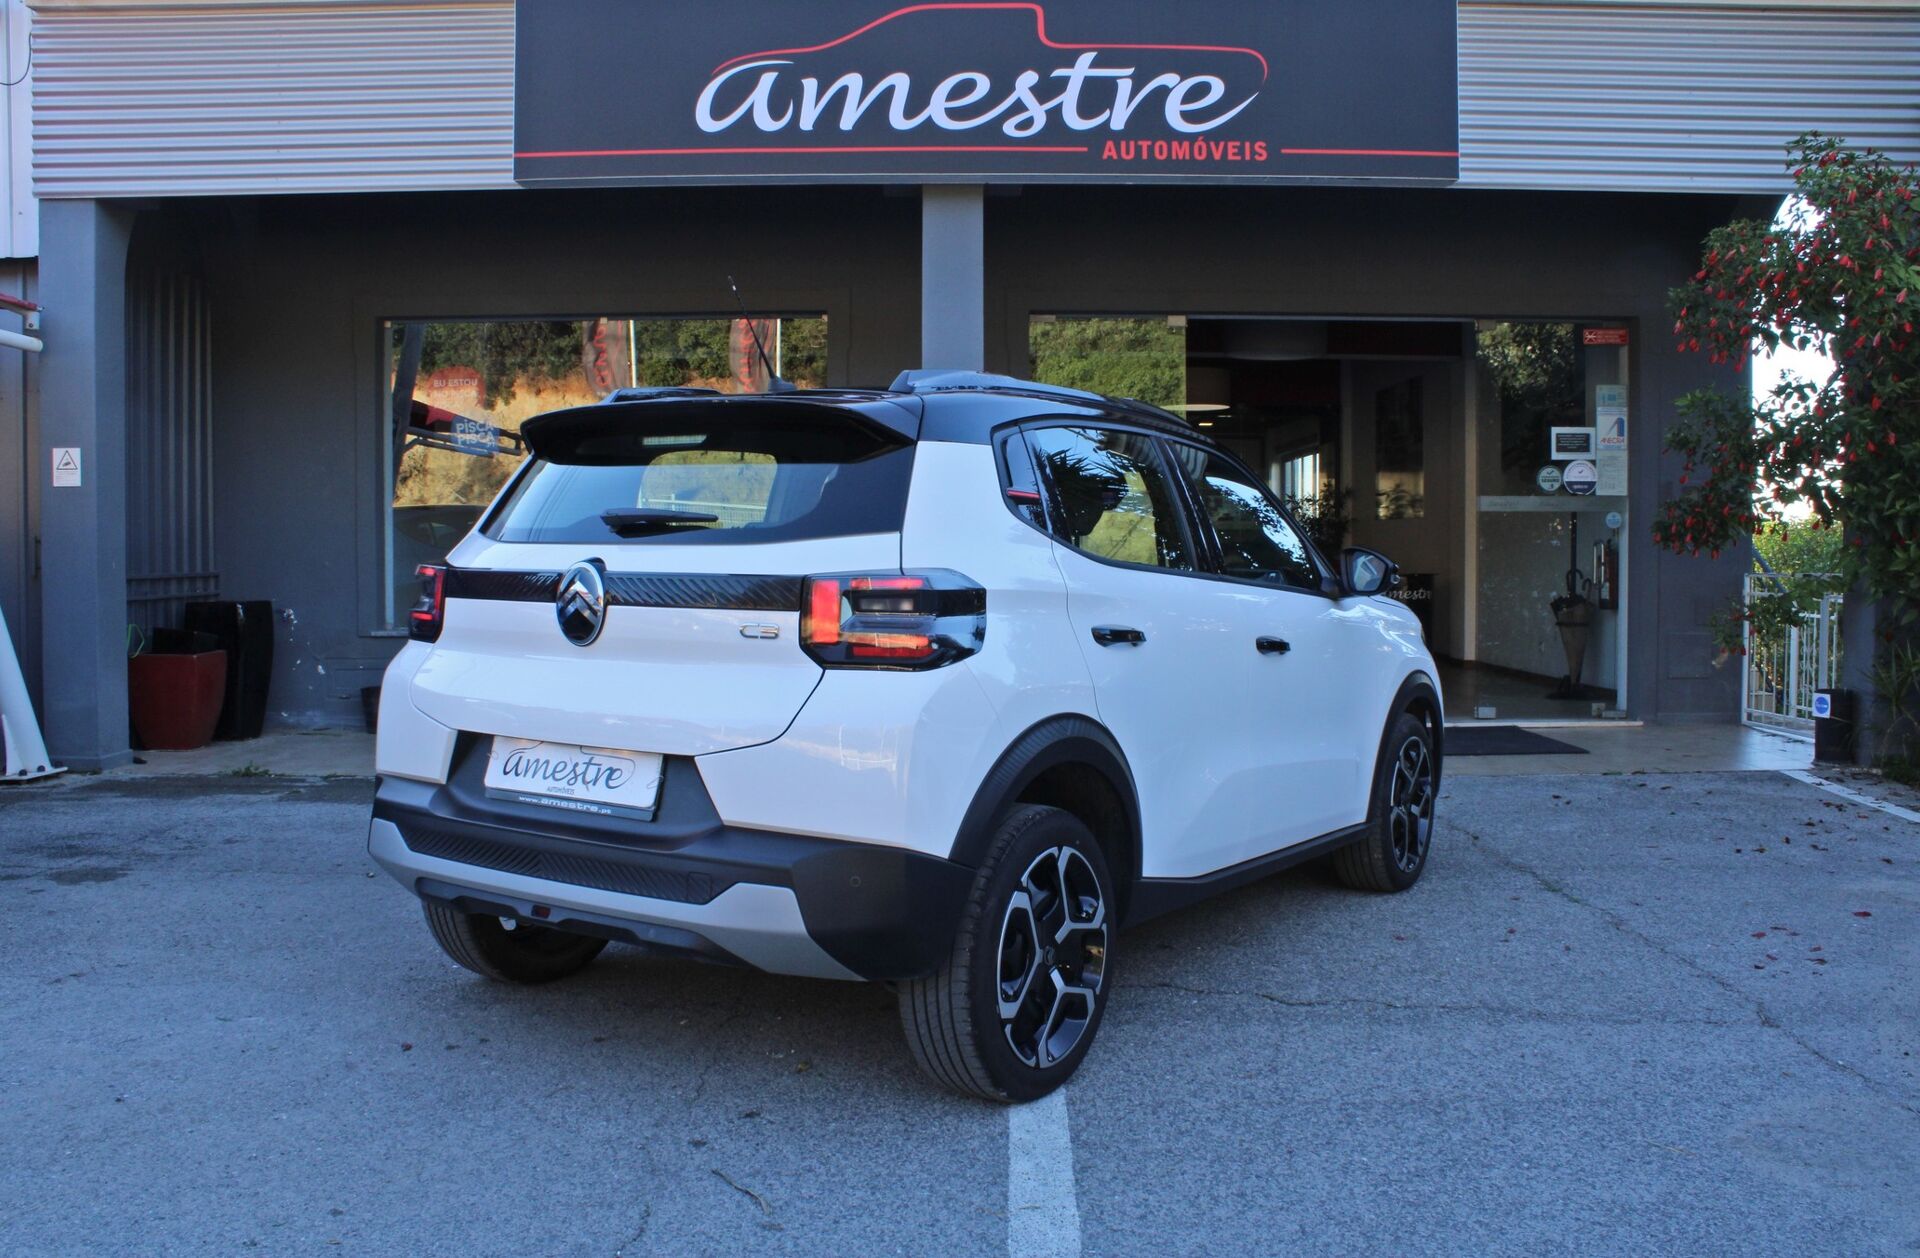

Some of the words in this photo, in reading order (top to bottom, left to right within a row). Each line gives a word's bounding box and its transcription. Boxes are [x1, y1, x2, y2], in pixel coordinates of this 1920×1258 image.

[695, 52, 1259, 138] amestre
[1102, 137, 1268, 161] AUTOMÓVEIS
[433, 379, 446, 387] EU
[739, 622, 779, 640] C3
[503, 751, 632, 789] amestre
